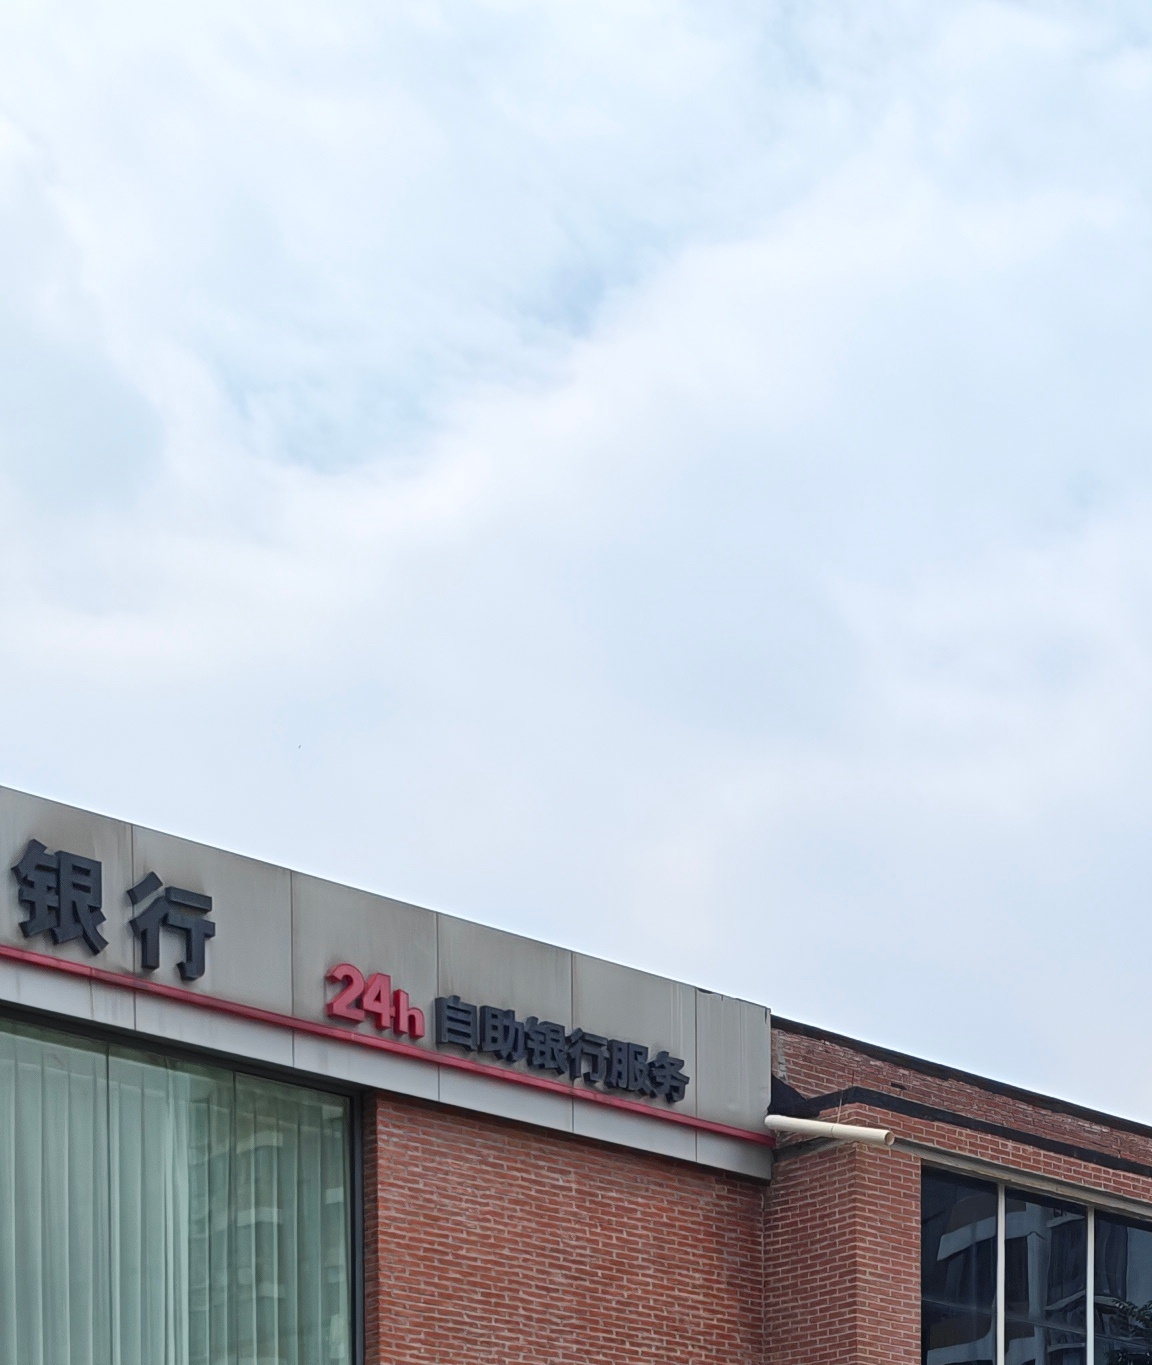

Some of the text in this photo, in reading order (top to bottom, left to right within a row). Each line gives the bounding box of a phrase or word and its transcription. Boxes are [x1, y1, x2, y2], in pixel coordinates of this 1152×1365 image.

[11, 838, 216, 981] 银行
[325, 963, 690, 1104] 24h 自助银行服务
